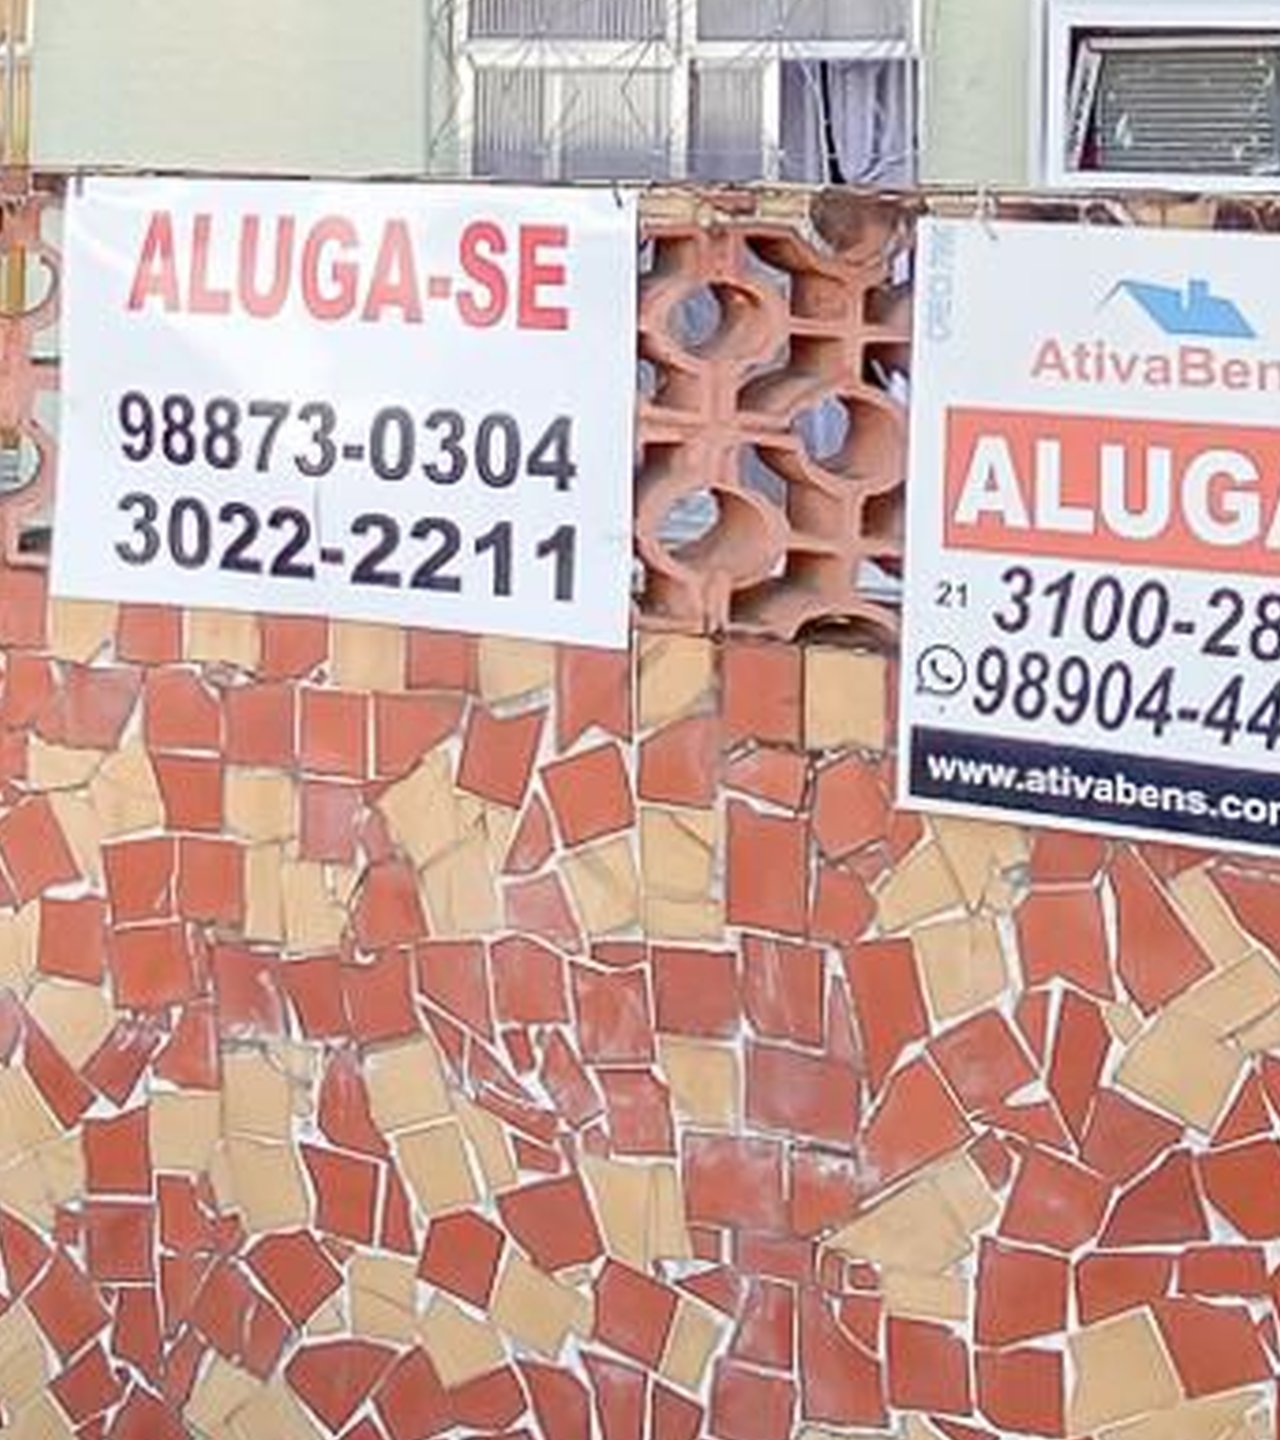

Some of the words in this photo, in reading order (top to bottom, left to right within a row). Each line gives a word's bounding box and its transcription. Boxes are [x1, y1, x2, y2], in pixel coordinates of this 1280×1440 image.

[126, 210, 569, 331] ALUGA-SE
[117, 390, 578, 492] 98873-0304
[114, 492, 577, 602] 3022-2211
[935, 579, 969, 610] 21
